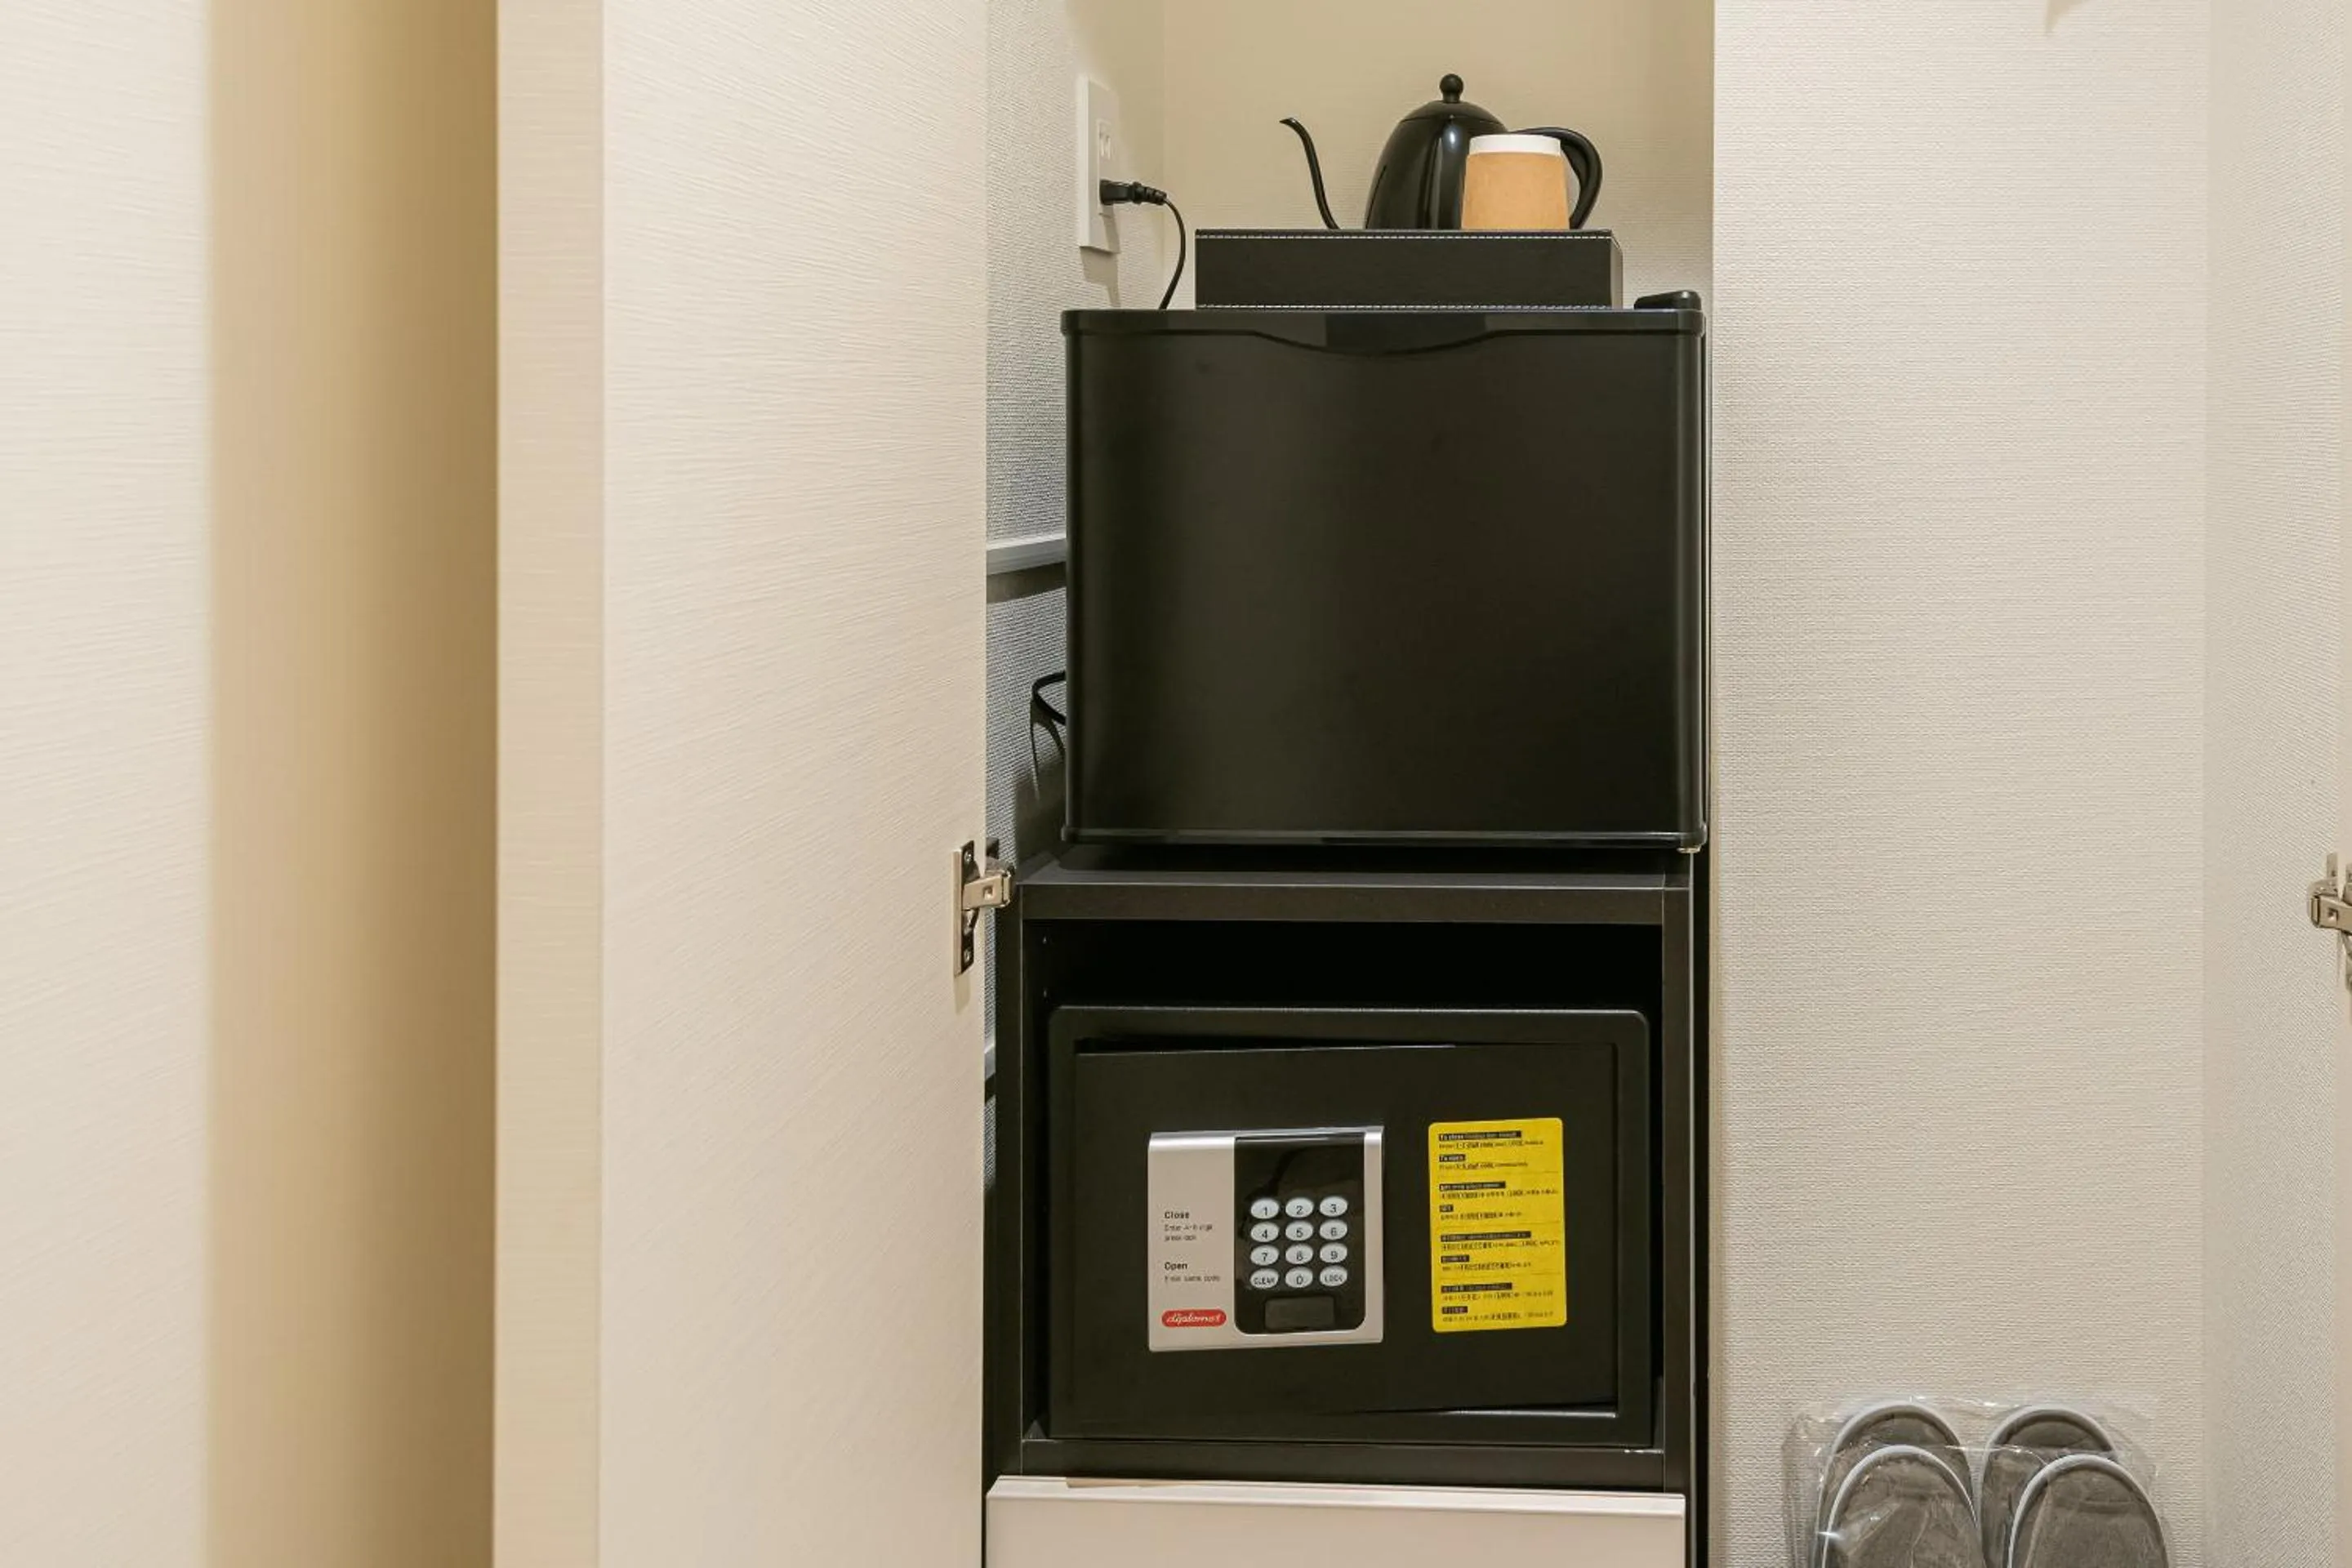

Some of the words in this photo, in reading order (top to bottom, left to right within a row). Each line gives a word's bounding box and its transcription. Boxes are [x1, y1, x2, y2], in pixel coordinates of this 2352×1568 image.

[1164, 1211, 1190, 1219] Close
[1296, 1205, 1303, 1215] 2
[1330, 1204, 1337, 1214] 3
[1261, 1229, 1268, 1239] 4
[1296, 1228, 1303, 1238] 5
[1330, 1227, 1338, 1237] 6
[1261, 1252, 1267, 1262] 7
[1296, 1251, 1304, 1262] 8
[1330, 1250, 1338, 1260] 9
[1164, 1262, 1188, 1271] Open
[1296, 1275, 1303, 1285] 0
[1324, 1274, 1343, 1283] LOCK
